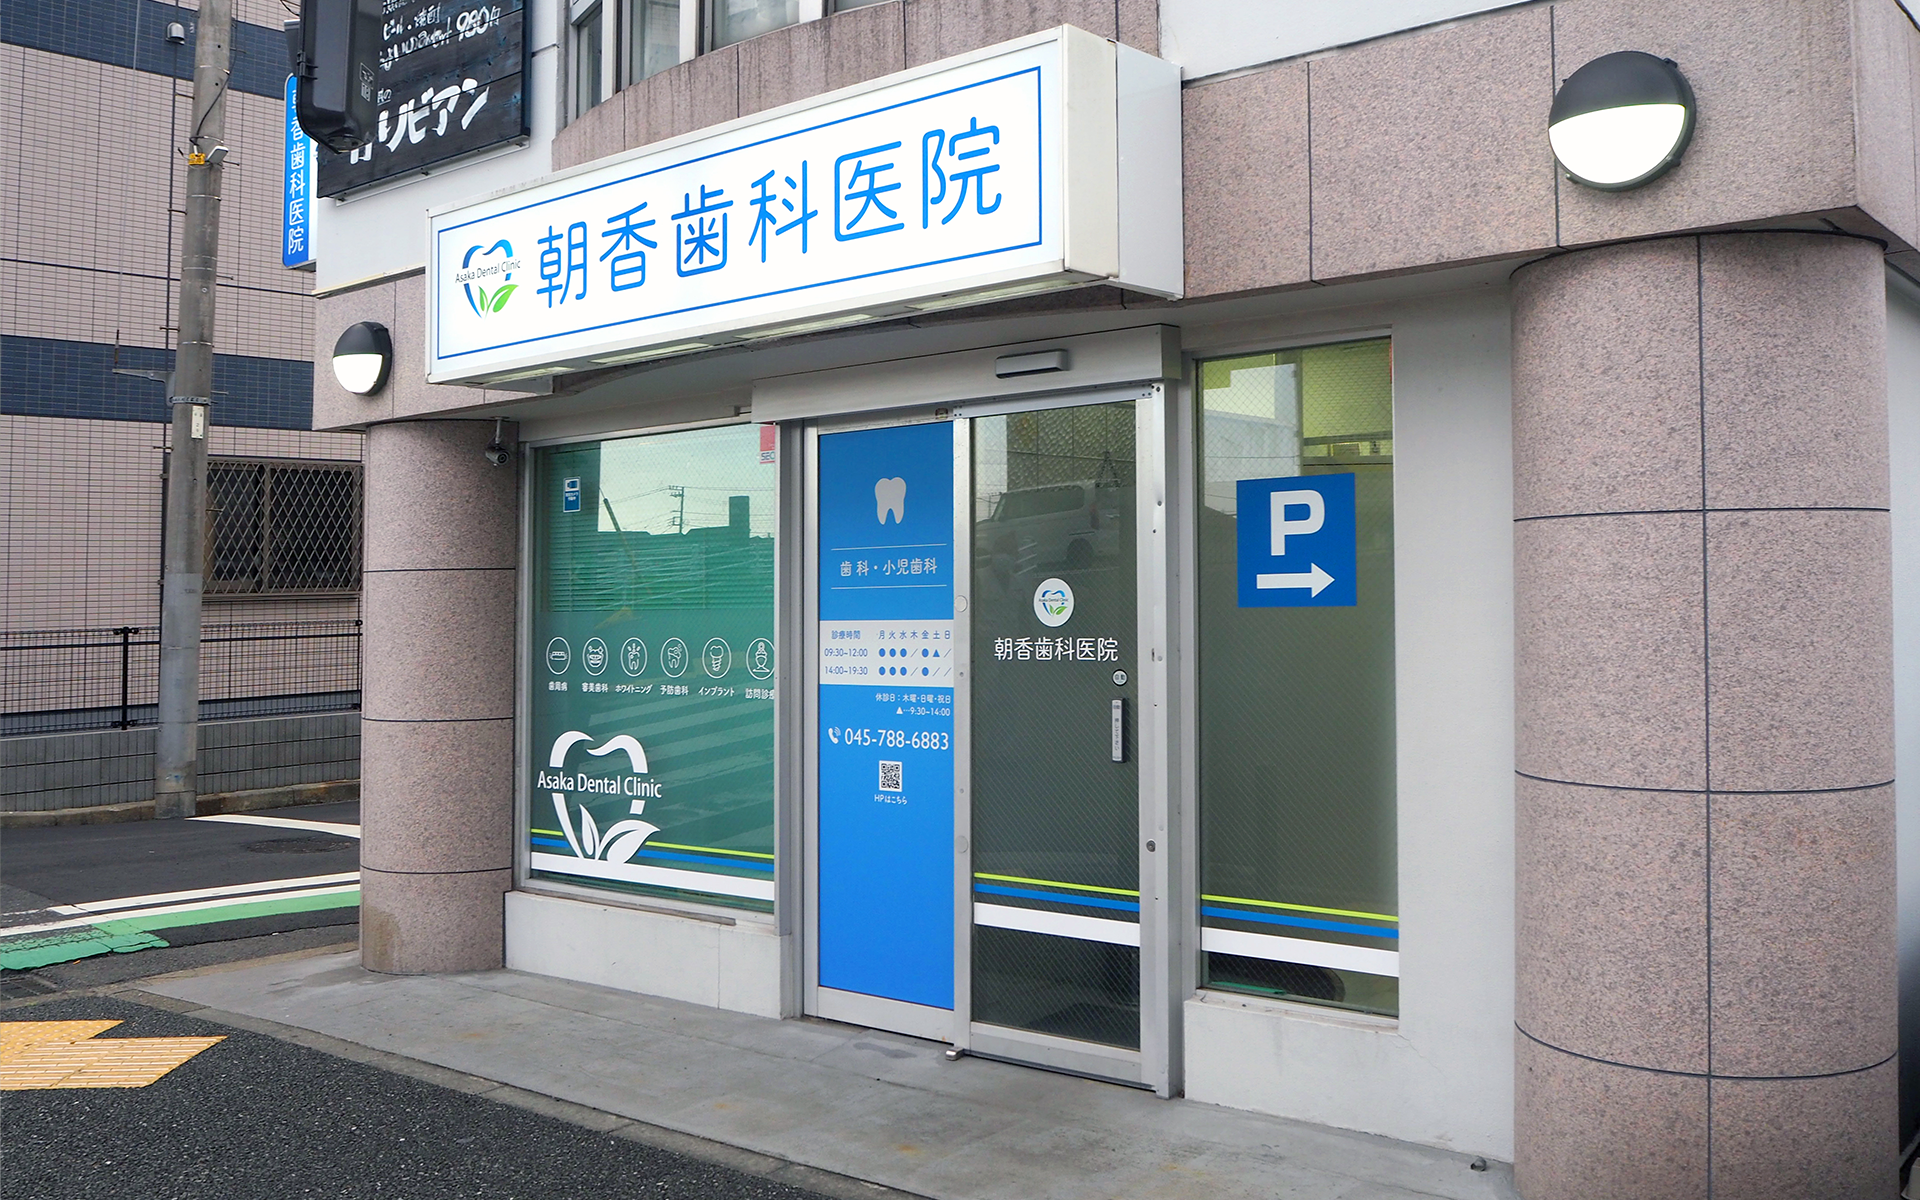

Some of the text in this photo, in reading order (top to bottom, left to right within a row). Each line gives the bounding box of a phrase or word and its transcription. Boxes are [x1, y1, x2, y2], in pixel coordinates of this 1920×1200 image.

[288, 89, 306, 255] 香歯科医院
[536, 116, 1002, 309] 朝香歯科医院
[455, 259, 521, 284] Asaka Dental Clinic
[1270, 489, 1326, 556] P
[840, 557, 938, 577] 歯科・小児歯科
[831, 629, 861, 641] 診療時間
[994, 636, 1119, 662] 朝香歯科医院
[614, 684, 653, 695] ホワイトニング
[660, 684, 689, 696] 予防歯科
[698, 686, 736, 697] インプラント
[844, 727, 949, 751] 045-788-6883
[537, 770, 662, 798] Asaka Dental Clinic
[874, 794, 908, 805] HPはこちら
